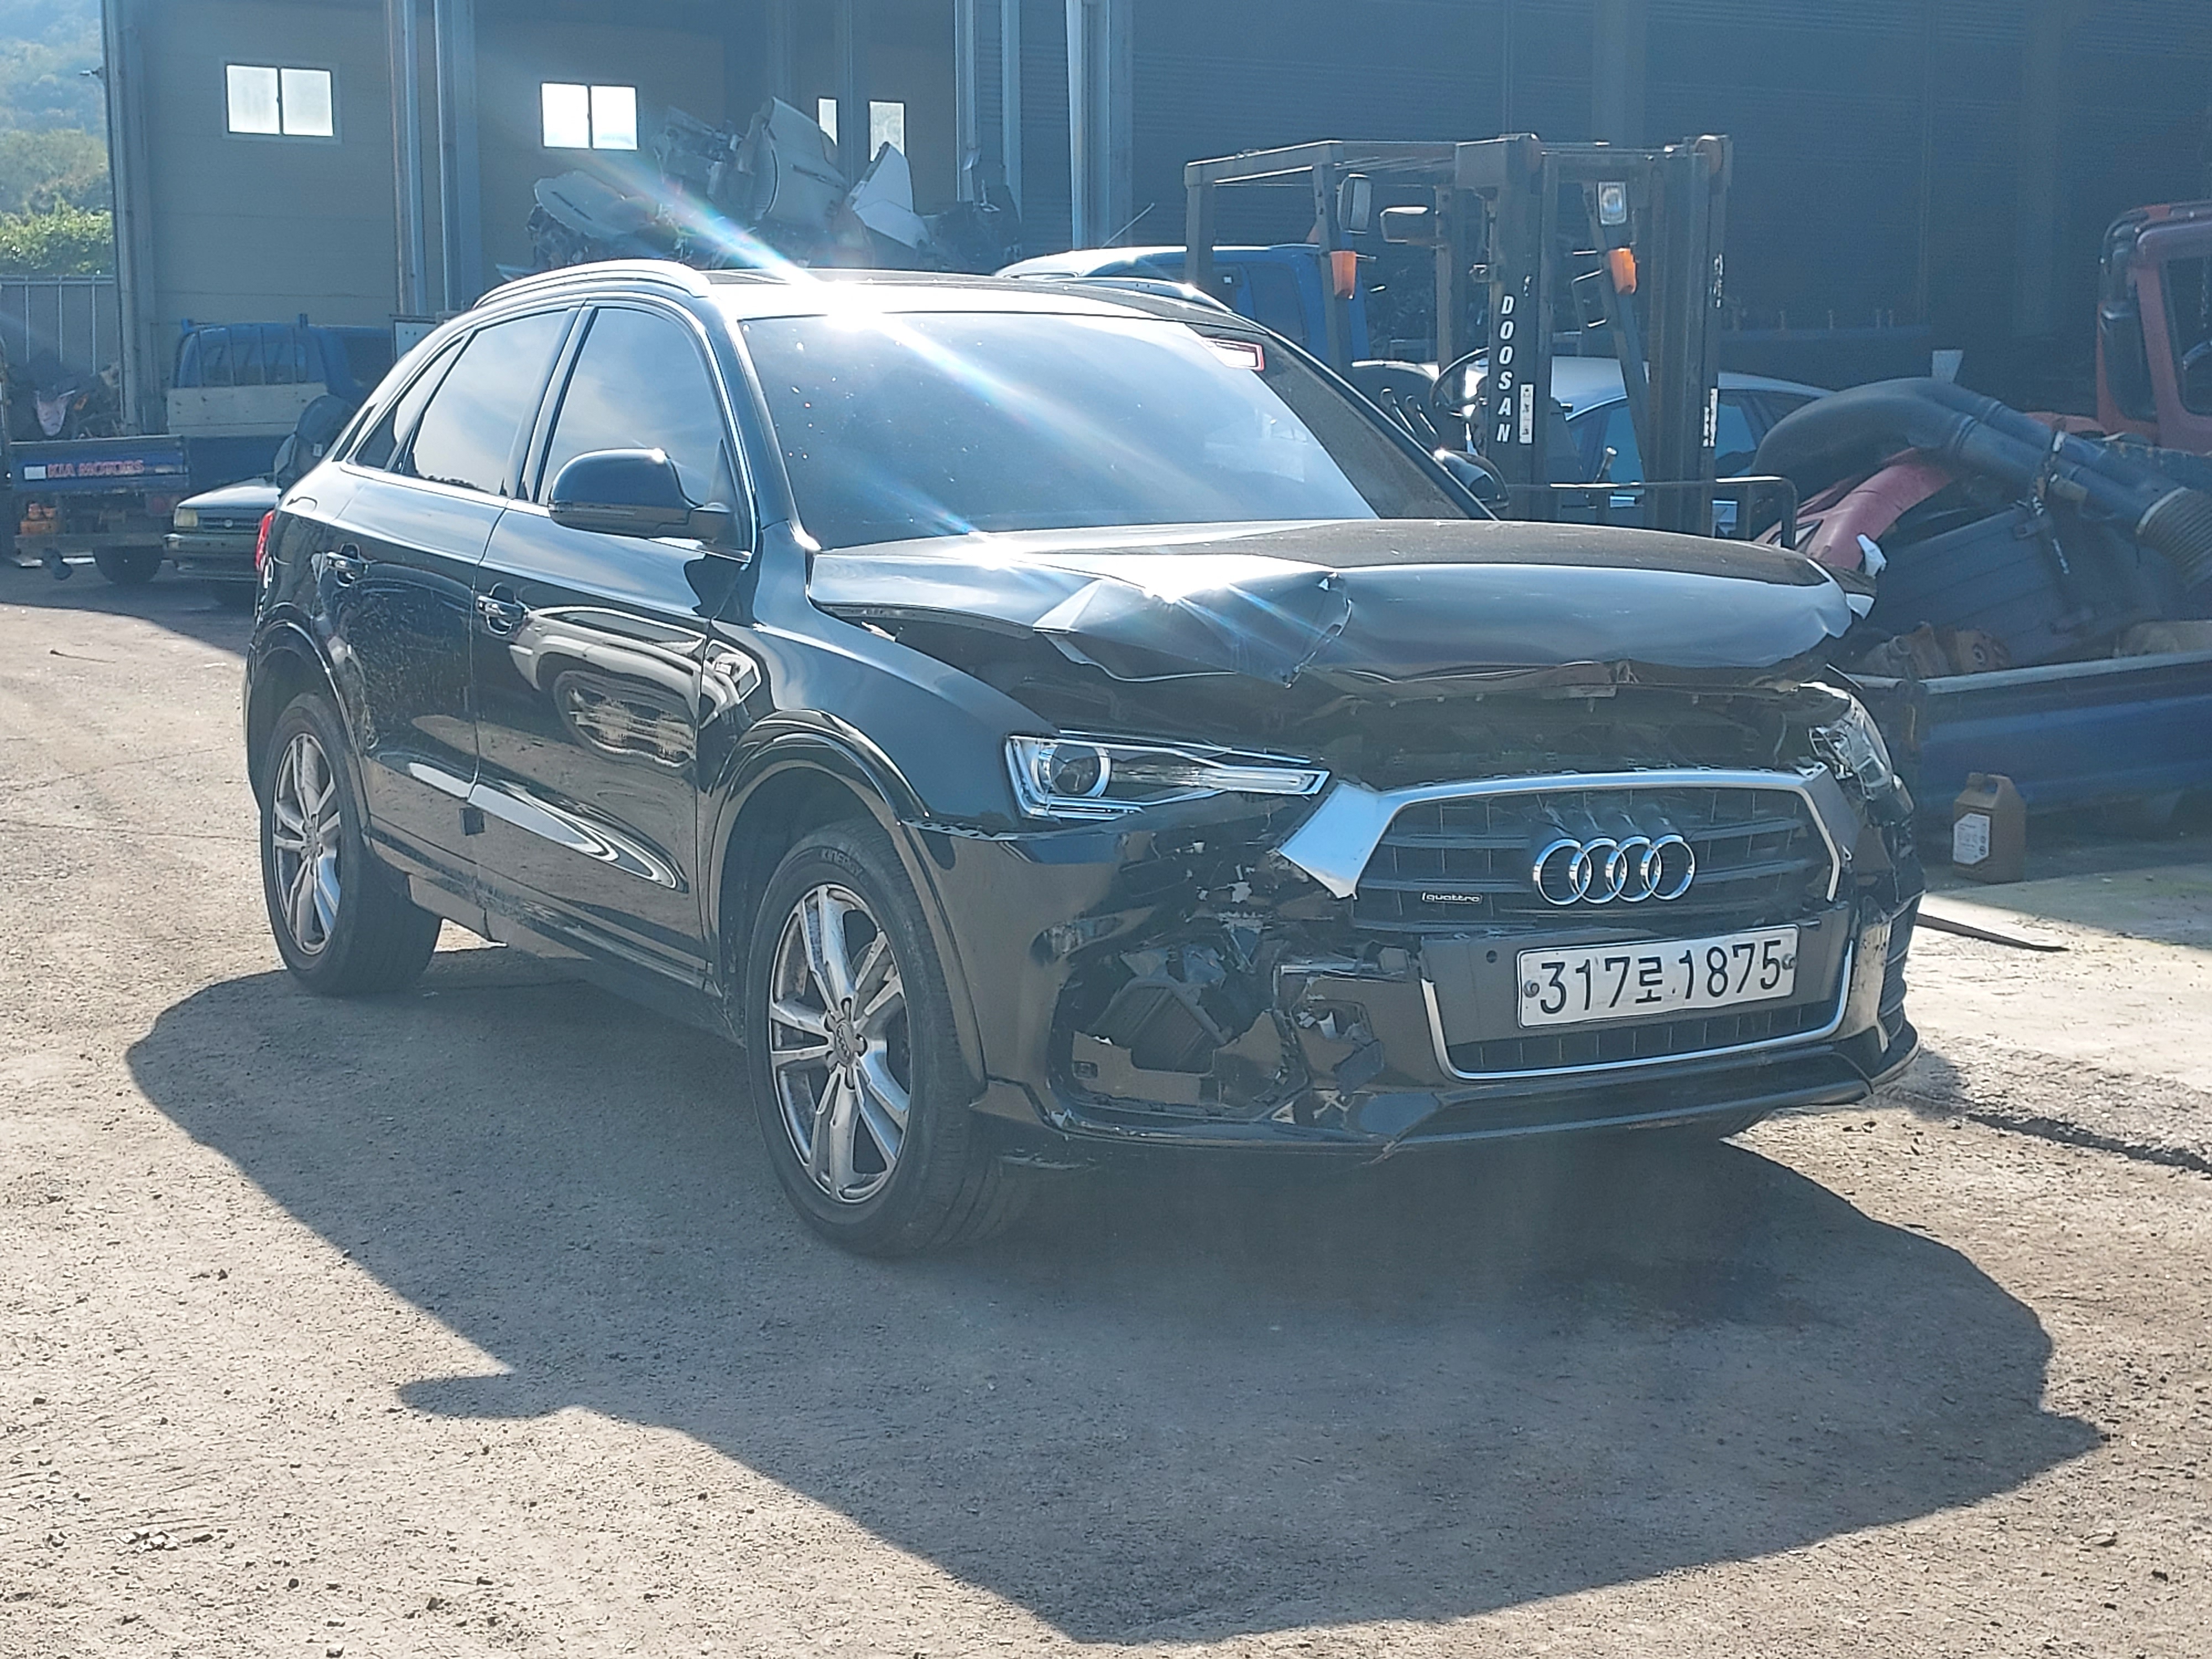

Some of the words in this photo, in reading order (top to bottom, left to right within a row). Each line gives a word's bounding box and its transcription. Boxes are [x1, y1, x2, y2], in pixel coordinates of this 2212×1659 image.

[1496, 295, 1514, 442] DOOSAN
[48, 463, 75, 478] KIA
[79, 460, 145, 477] MOTORS
[1426, 894, 1480, 903] quattro
